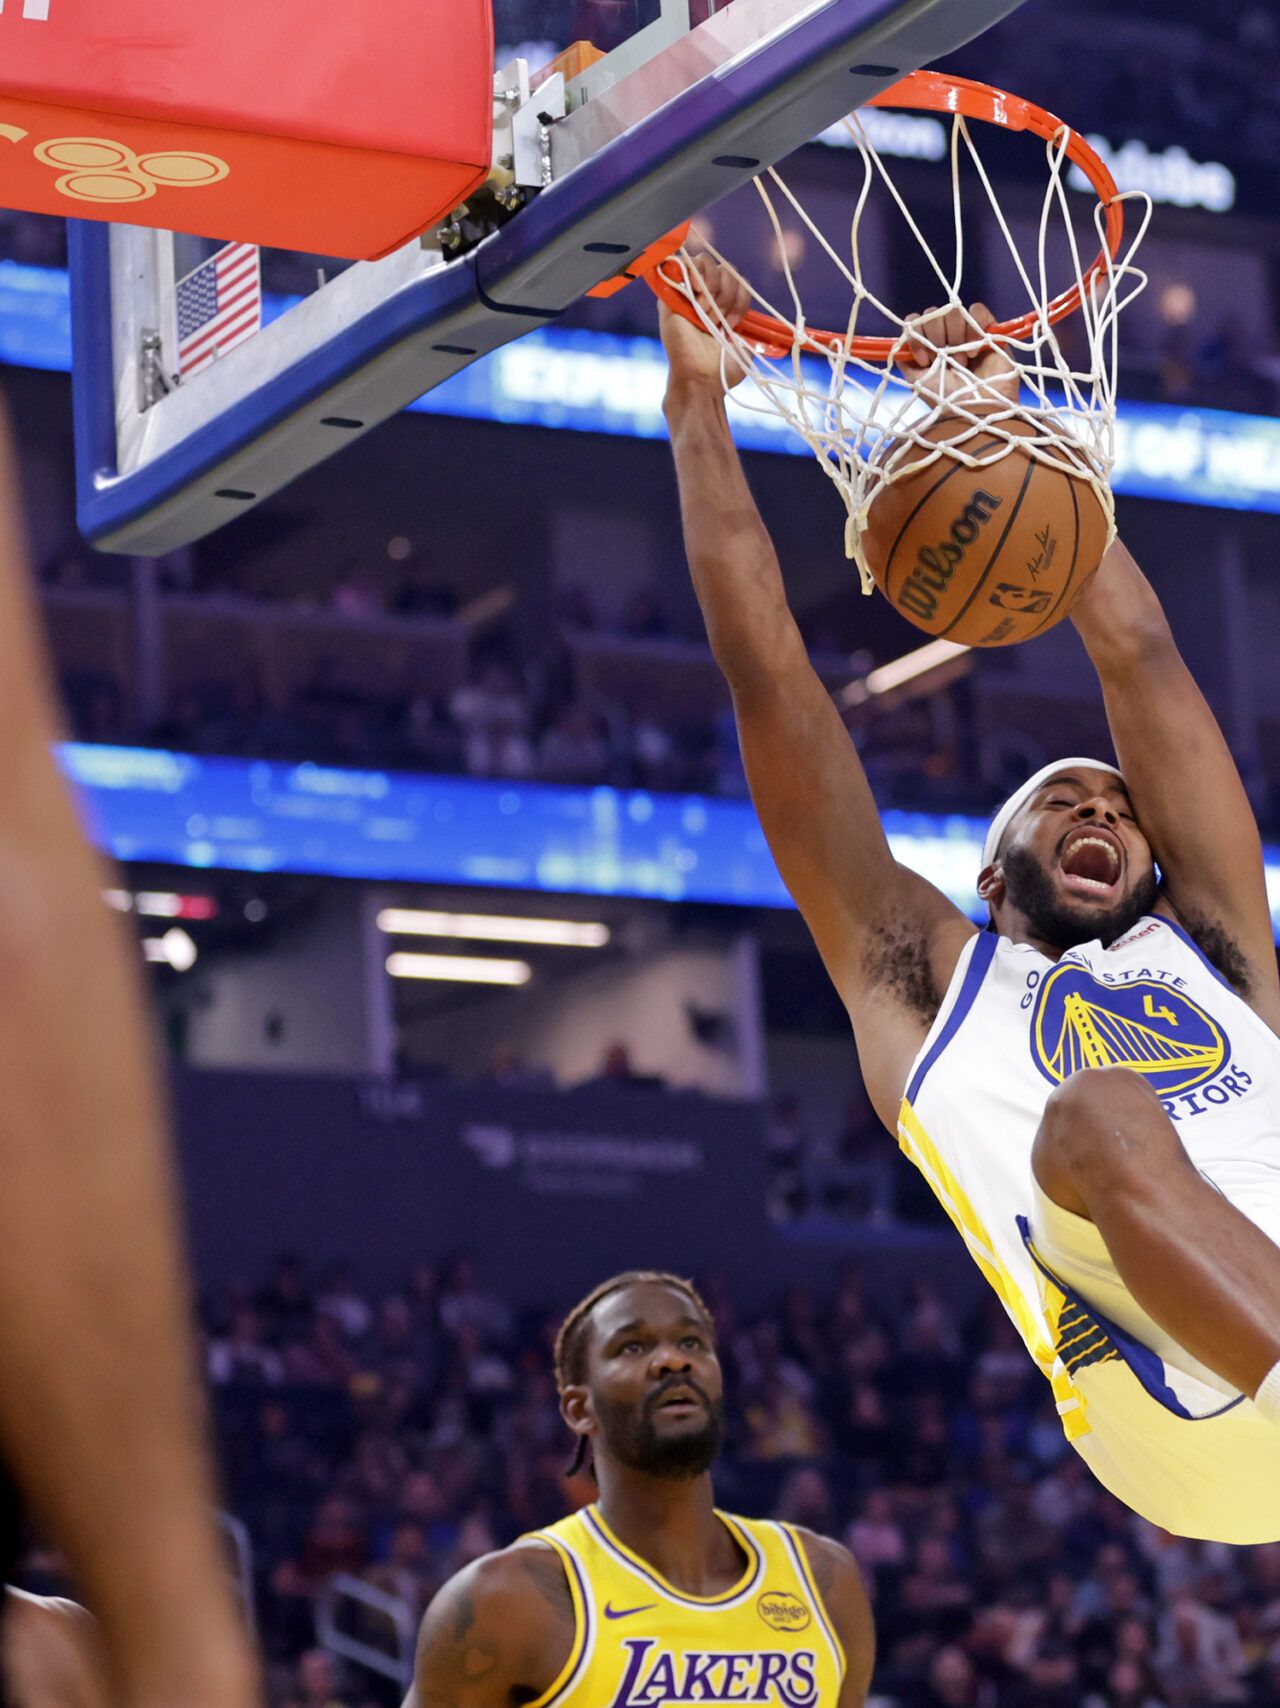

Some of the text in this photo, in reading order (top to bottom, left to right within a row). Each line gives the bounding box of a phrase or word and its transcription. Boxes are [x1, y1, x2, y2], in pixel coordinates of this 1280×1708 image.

[897, 487, 1003, 620] Wilson
[1102, 968, 1188, 989] STATE
[1142, 994, 1180, 1027] 4
[1160, 1063, 1252, 1121] RIORS
[609, 1639, 818, 1708] LAKERS
